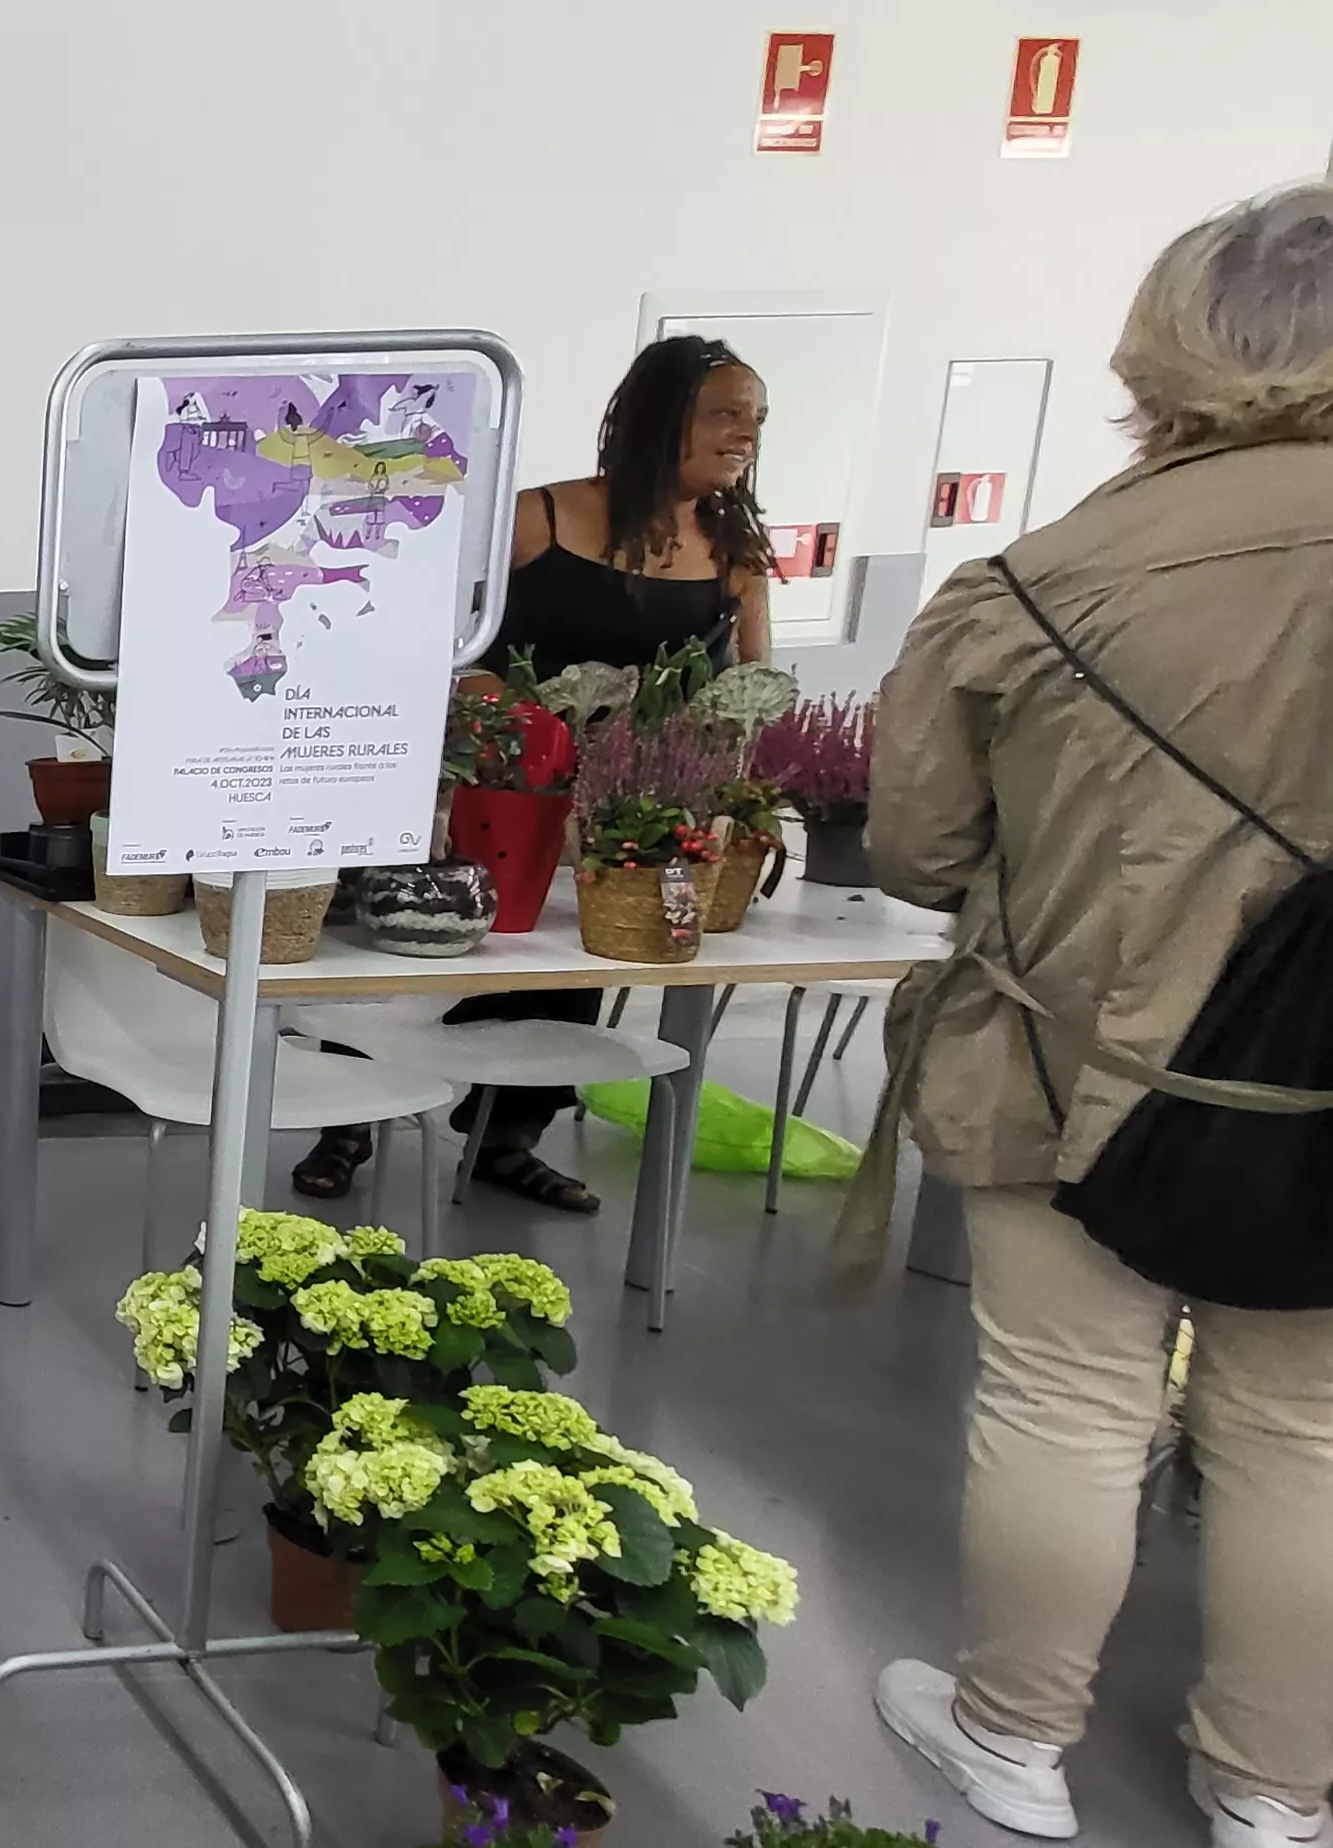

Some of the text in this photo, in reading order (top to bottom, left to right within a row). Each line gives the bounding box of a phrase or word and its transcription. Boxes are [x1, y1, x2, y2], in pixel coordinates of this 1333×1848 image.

[285, 684, 311, 701] DÍA
[284, 704, 399, 720] INTERNACIONAL
[282, 726, 331, 739] DE LAS
[280, 744, 345, 760] MUJERES
[348, 743, 409, 757] RURALES
[173, 765, 274, 775] PALACIO DE CONGRESOS
[279, 764, 293, 773] Las
[228, 791, 272, 803] HUESCA
